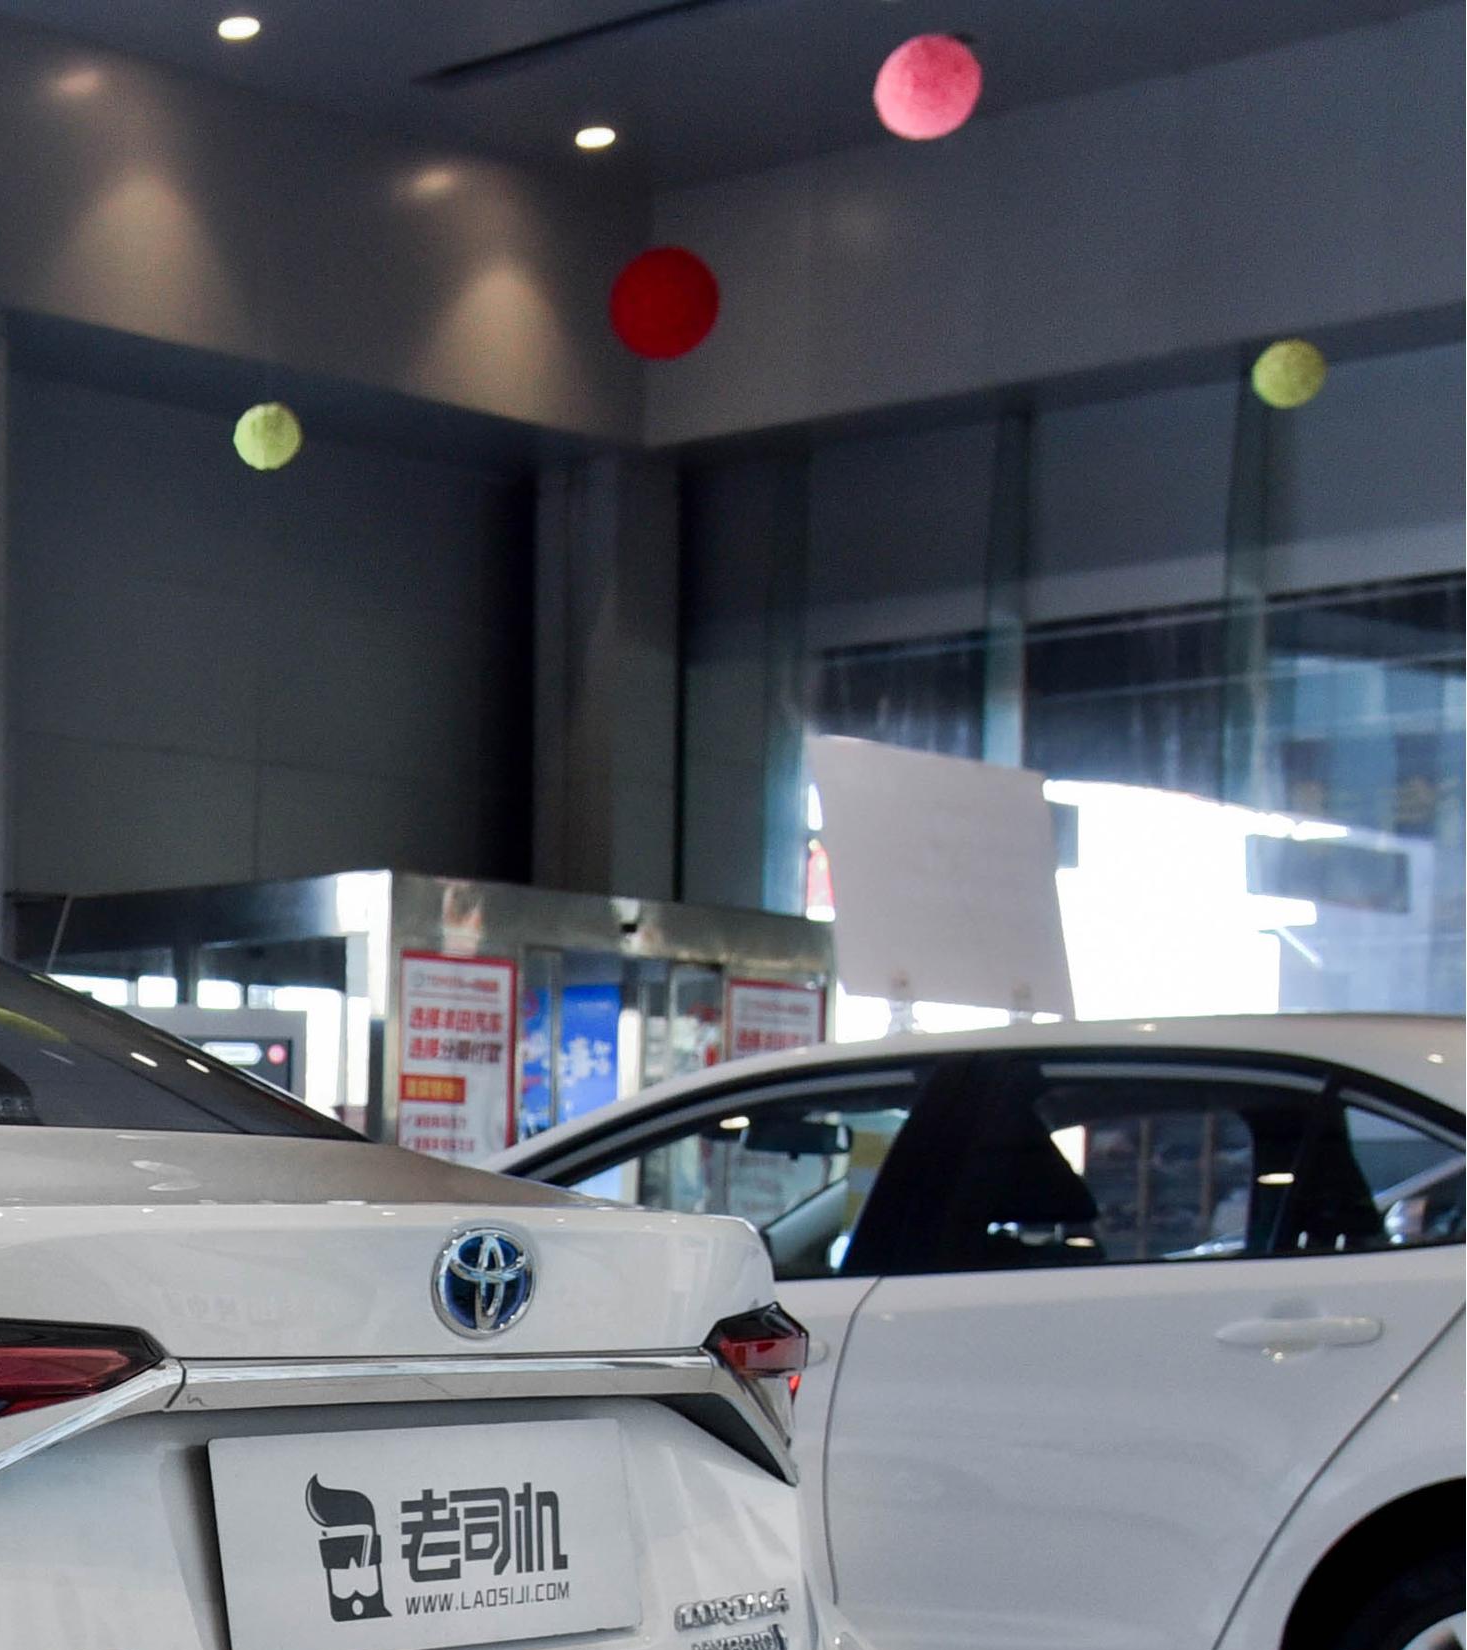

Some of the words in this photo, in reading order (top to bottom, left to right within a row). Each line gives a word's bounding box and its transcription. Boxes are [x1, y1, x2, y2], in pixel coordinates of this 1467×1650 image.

[401, 1482, 568, 1582] 老司机
[405, 1580, 570, 1615] WWW.LAOSIJI.COM
[674, 1588, 790, 1632] COROLLA
